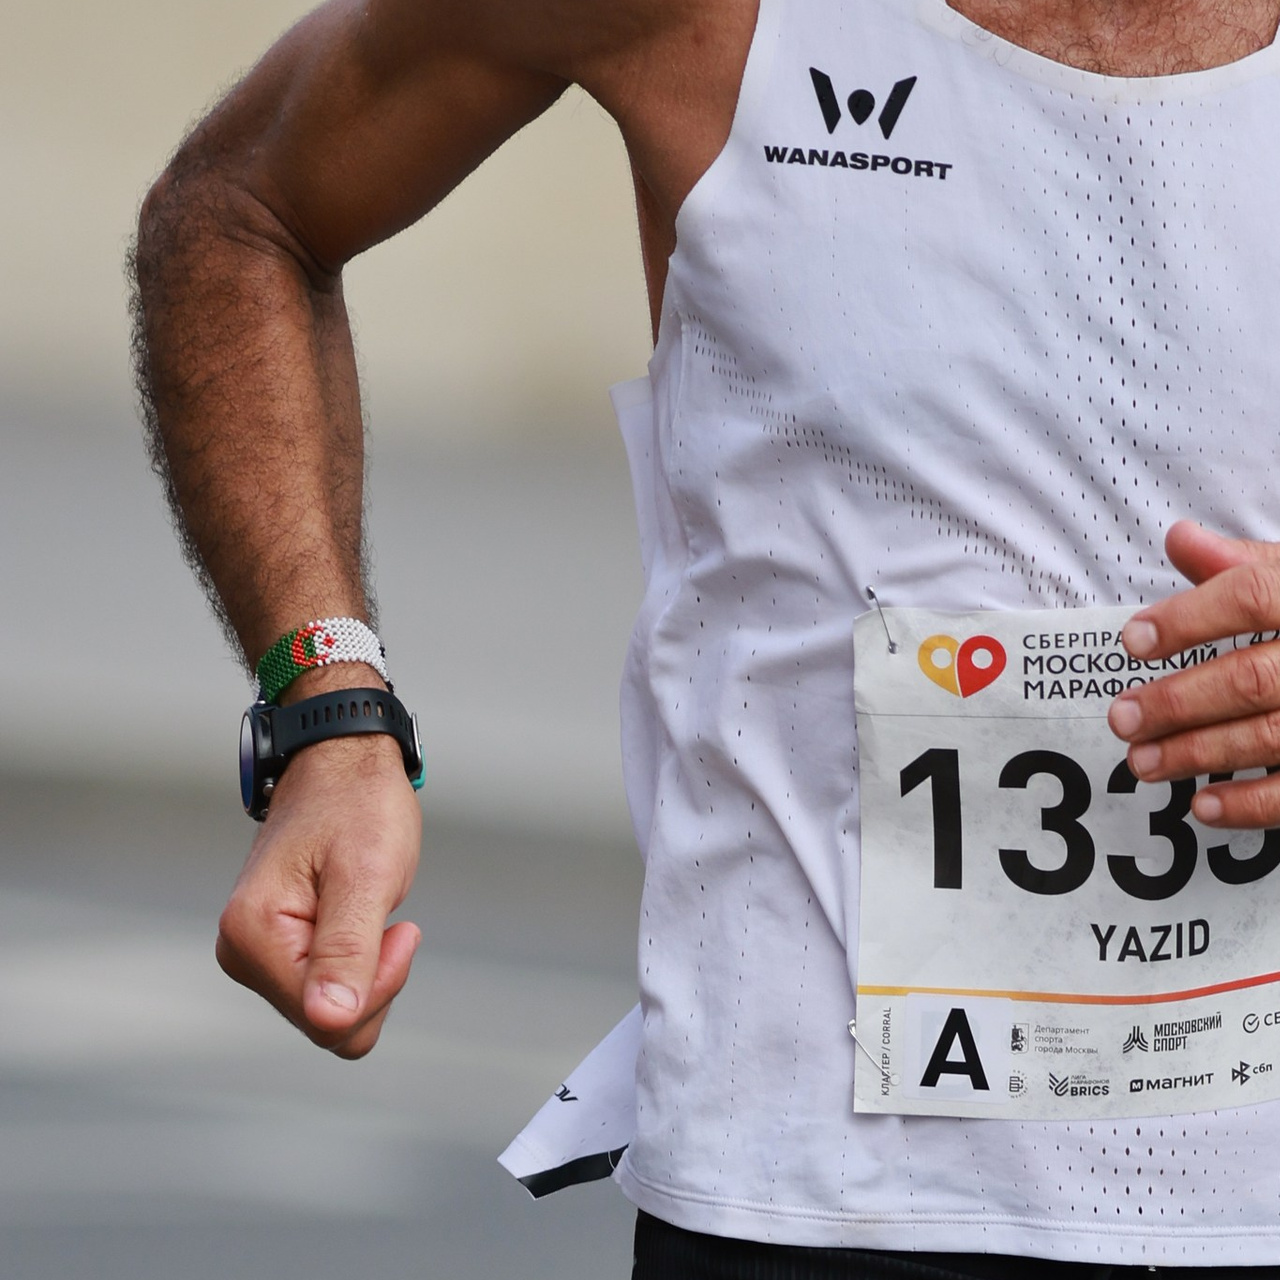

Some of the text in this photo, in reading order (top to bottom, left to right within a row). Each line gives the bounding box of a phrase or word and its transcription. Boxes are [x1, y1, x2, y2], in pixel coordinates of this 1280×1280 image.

[763, 145, 953, 180] WANASPORT
[1090, 919, 1210, 962] YAZID
[883, 1007, 892, 1045] CORRAL
[1034, 1024, 1090, 1035] Департамент
[1153, 1011, 1223, 1038] МОСКОВСКИЙ
[1034, 1035, 1063, 1044] спорта
[1153, 1036, 1188, 1053] СПОРТ
[1034, 1046, 1099, 1054] города Москвы
[1252, 1062, 1273, 1075] сбп
[1146, 1072, 1214, 1090] магнит
[1070, 1085, 1110, 1097] BRICS
